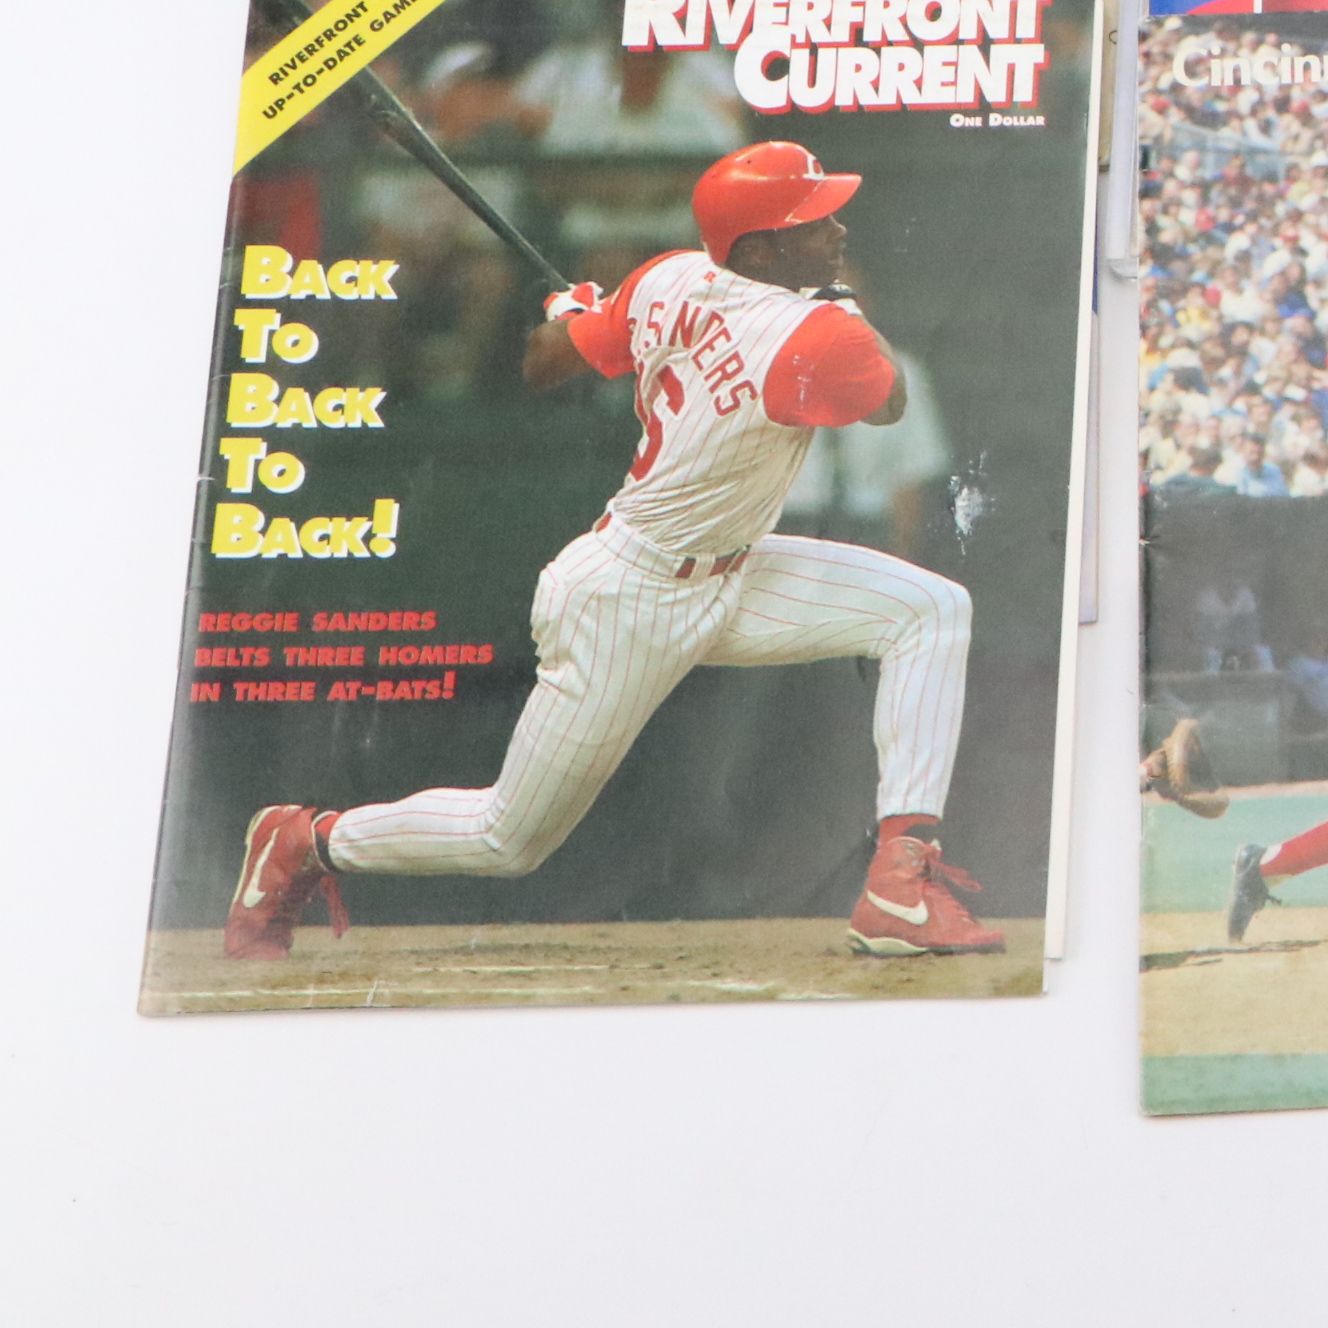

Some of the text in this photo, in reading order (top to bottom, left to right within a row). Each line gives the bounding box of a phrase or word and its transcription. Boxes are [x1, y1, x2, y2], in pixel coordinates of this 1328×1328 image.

[261, 33, 367, 120] UP-TO-DATE
[198, 610, 438, 633] REGGIE SANDERS
[193, 644, 495, 667] BELTS THREE HOMERS
[189, 670, 458, 703] IN THREE AT-BATS!
